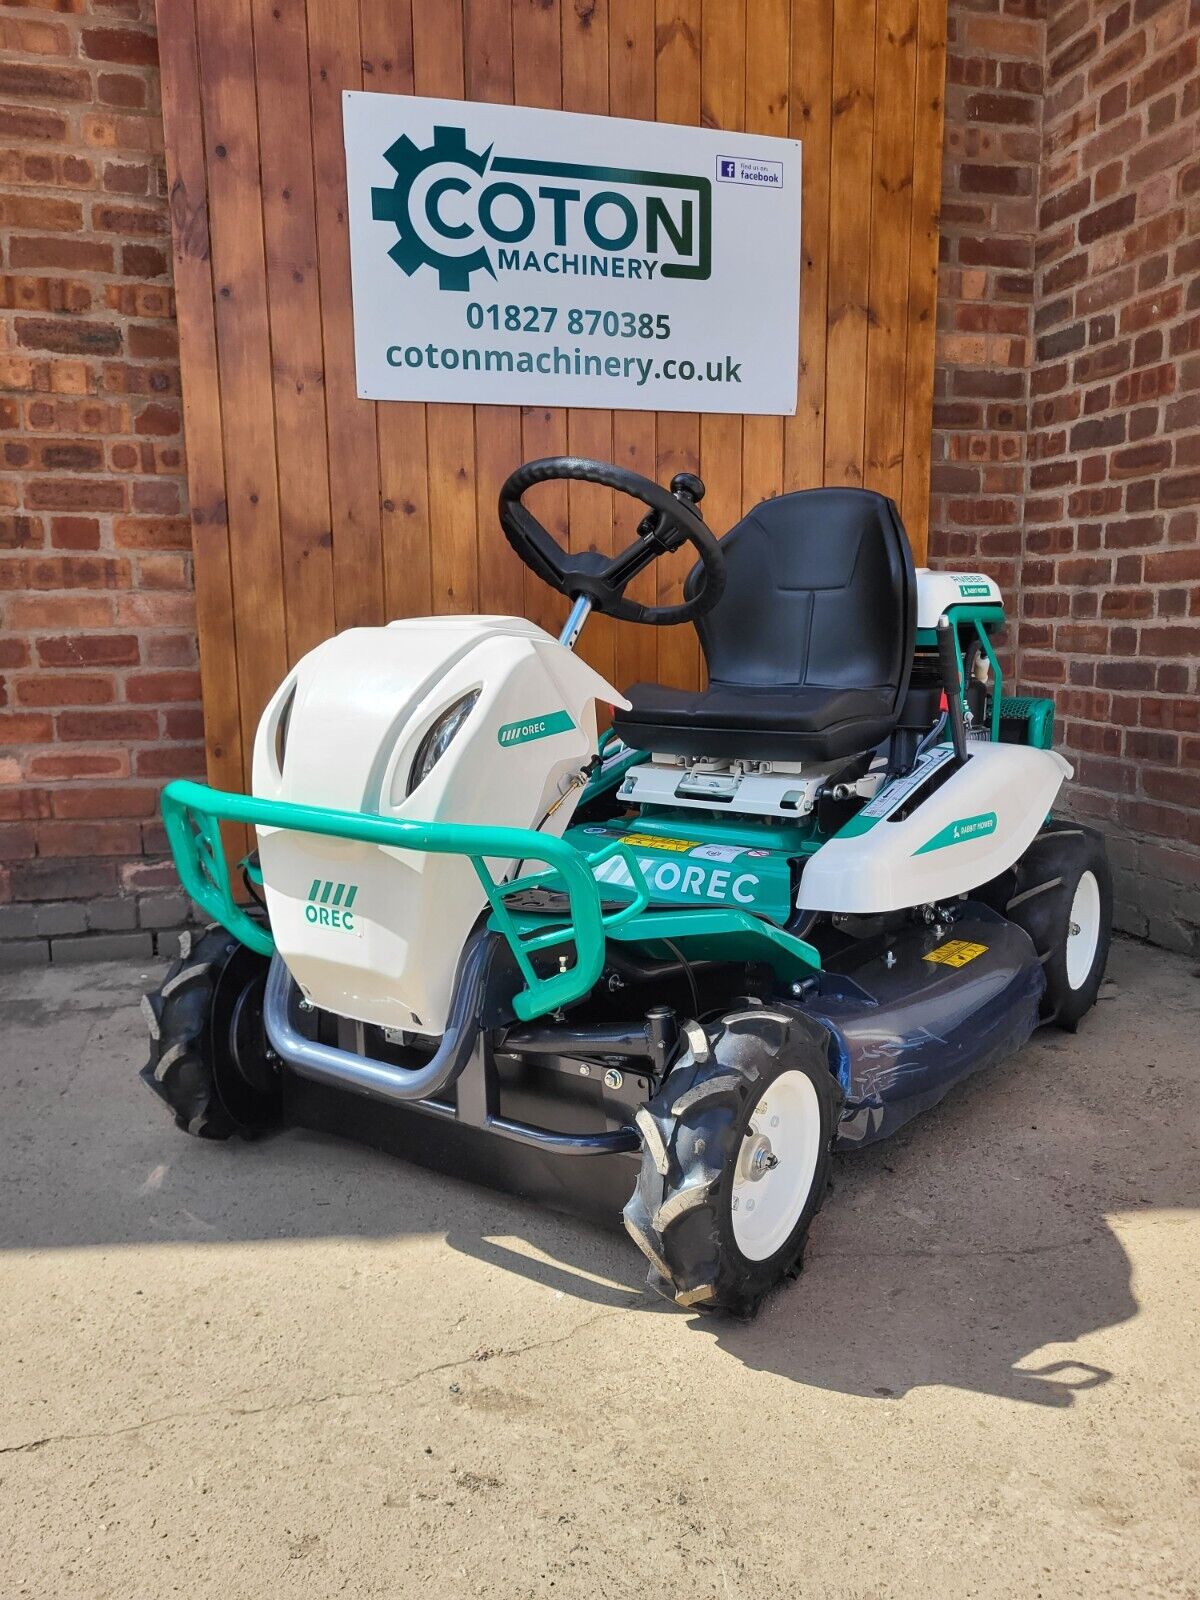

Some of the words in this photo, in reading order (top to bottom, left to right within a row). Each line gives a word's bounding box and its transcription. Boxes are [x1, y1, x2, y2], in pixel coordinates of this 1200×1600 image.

[741, 170, 779, 182] facebook
[425, 177, 693, 256] COTON
[498, 249, 658, 280] MACHINERY
[466, 302, 558, 333] 01827
[567, 309, 671, 340] 870385
[386, 343, 743, 386] cotonmachinery.co.uk
[522, 722, 546, 736] OREC
[655, 862, 760, 903] OREC
[305, 905, 354, 930] OREC
